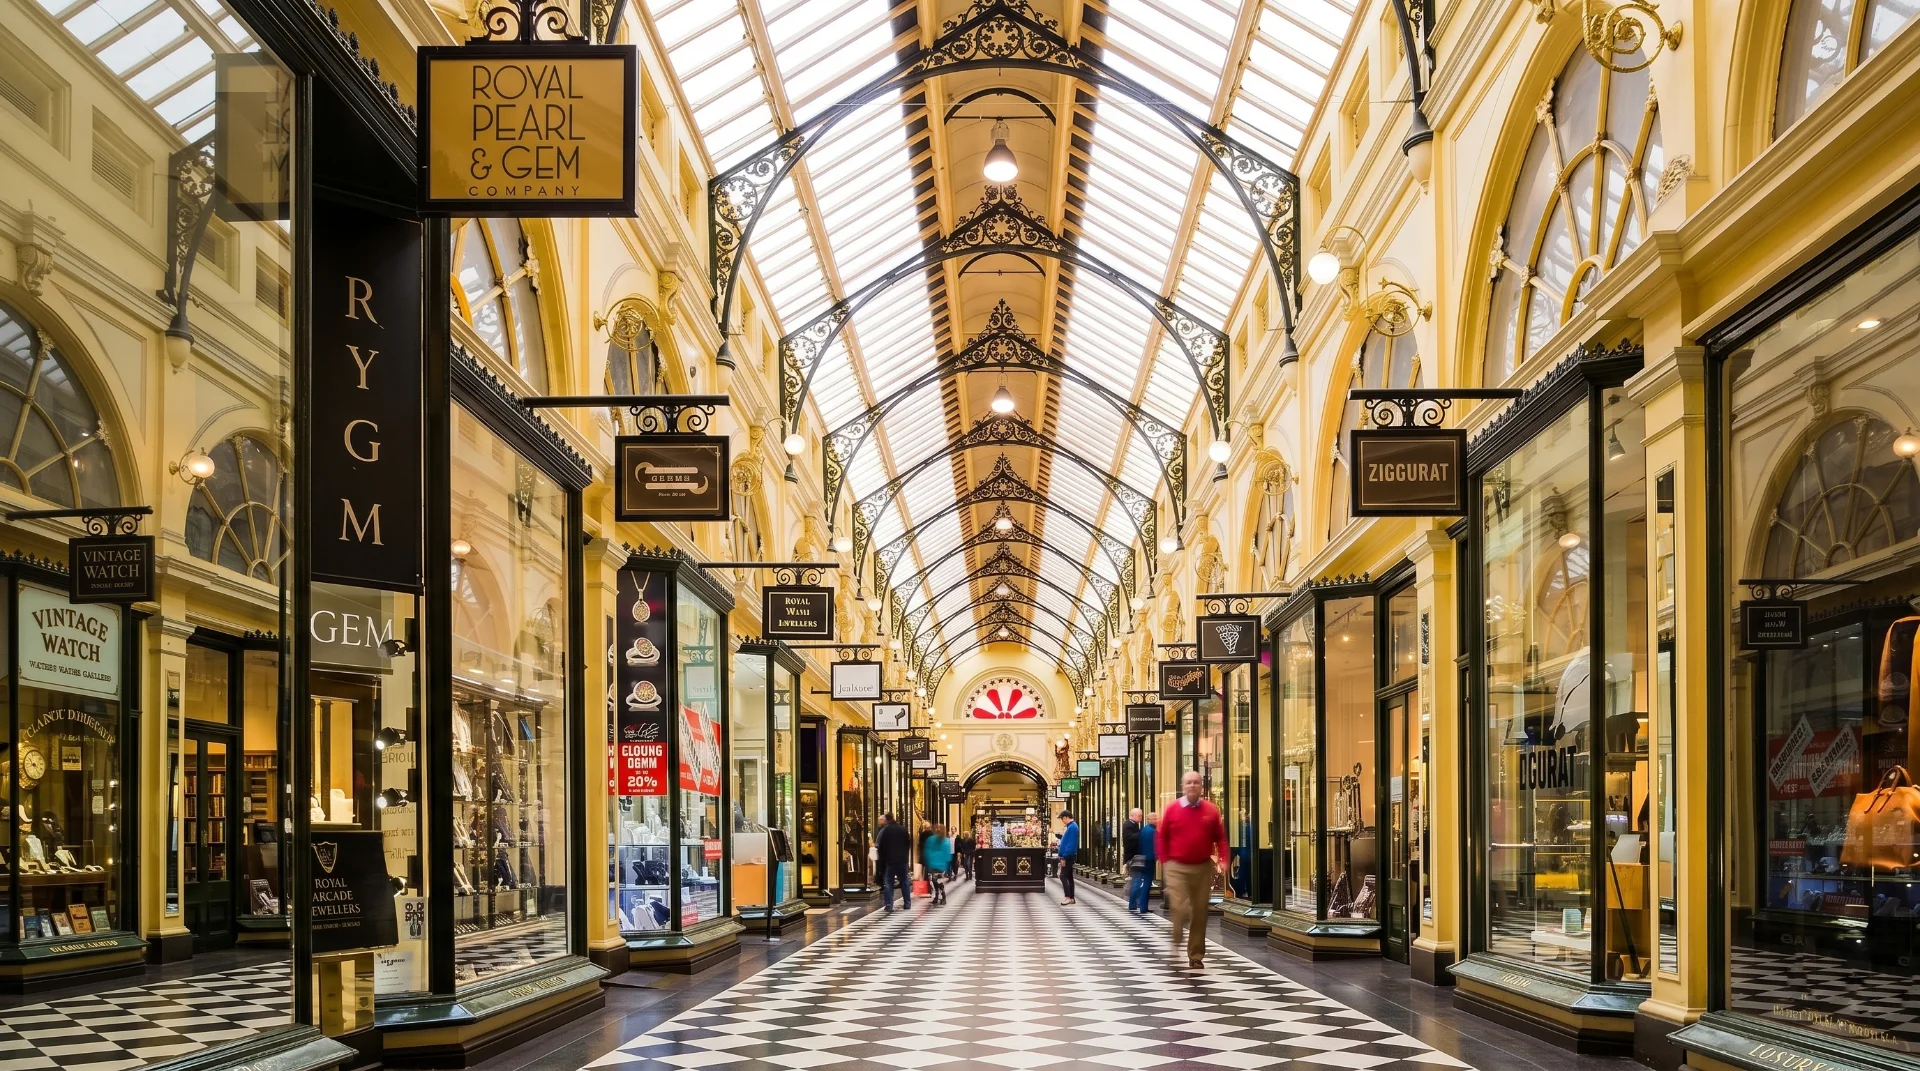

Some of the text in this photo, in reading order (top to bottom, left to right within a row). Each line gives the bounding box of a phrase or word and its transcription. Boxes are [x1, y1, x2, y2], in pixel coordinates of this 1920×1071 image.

[472, 65, 583, 99] ROYAL
[473, 104, 586, 141] PEARL
[470, 145, 580, 180] & GEM
[468, 185, 580, 196] COMPANY
[1368, 463, 1449, 482] ZIGGURAT
[83, 549, 141, 562] VINTAGE
[84, 564, 140, 579] WATCH
[785, 597, 810, 605] ROYAL
[31, 608, 109, 643] VINTAGE
[310, 610, 393, 648] GEM
[41, 632, 101, 663] WATCH
[627, 776, 658, 787] 20%
[314, 877, 347, 888] ROYAL
[312, 890, 353, 902] ARCADE
[311, 903, 361, 917] EWELLERS
